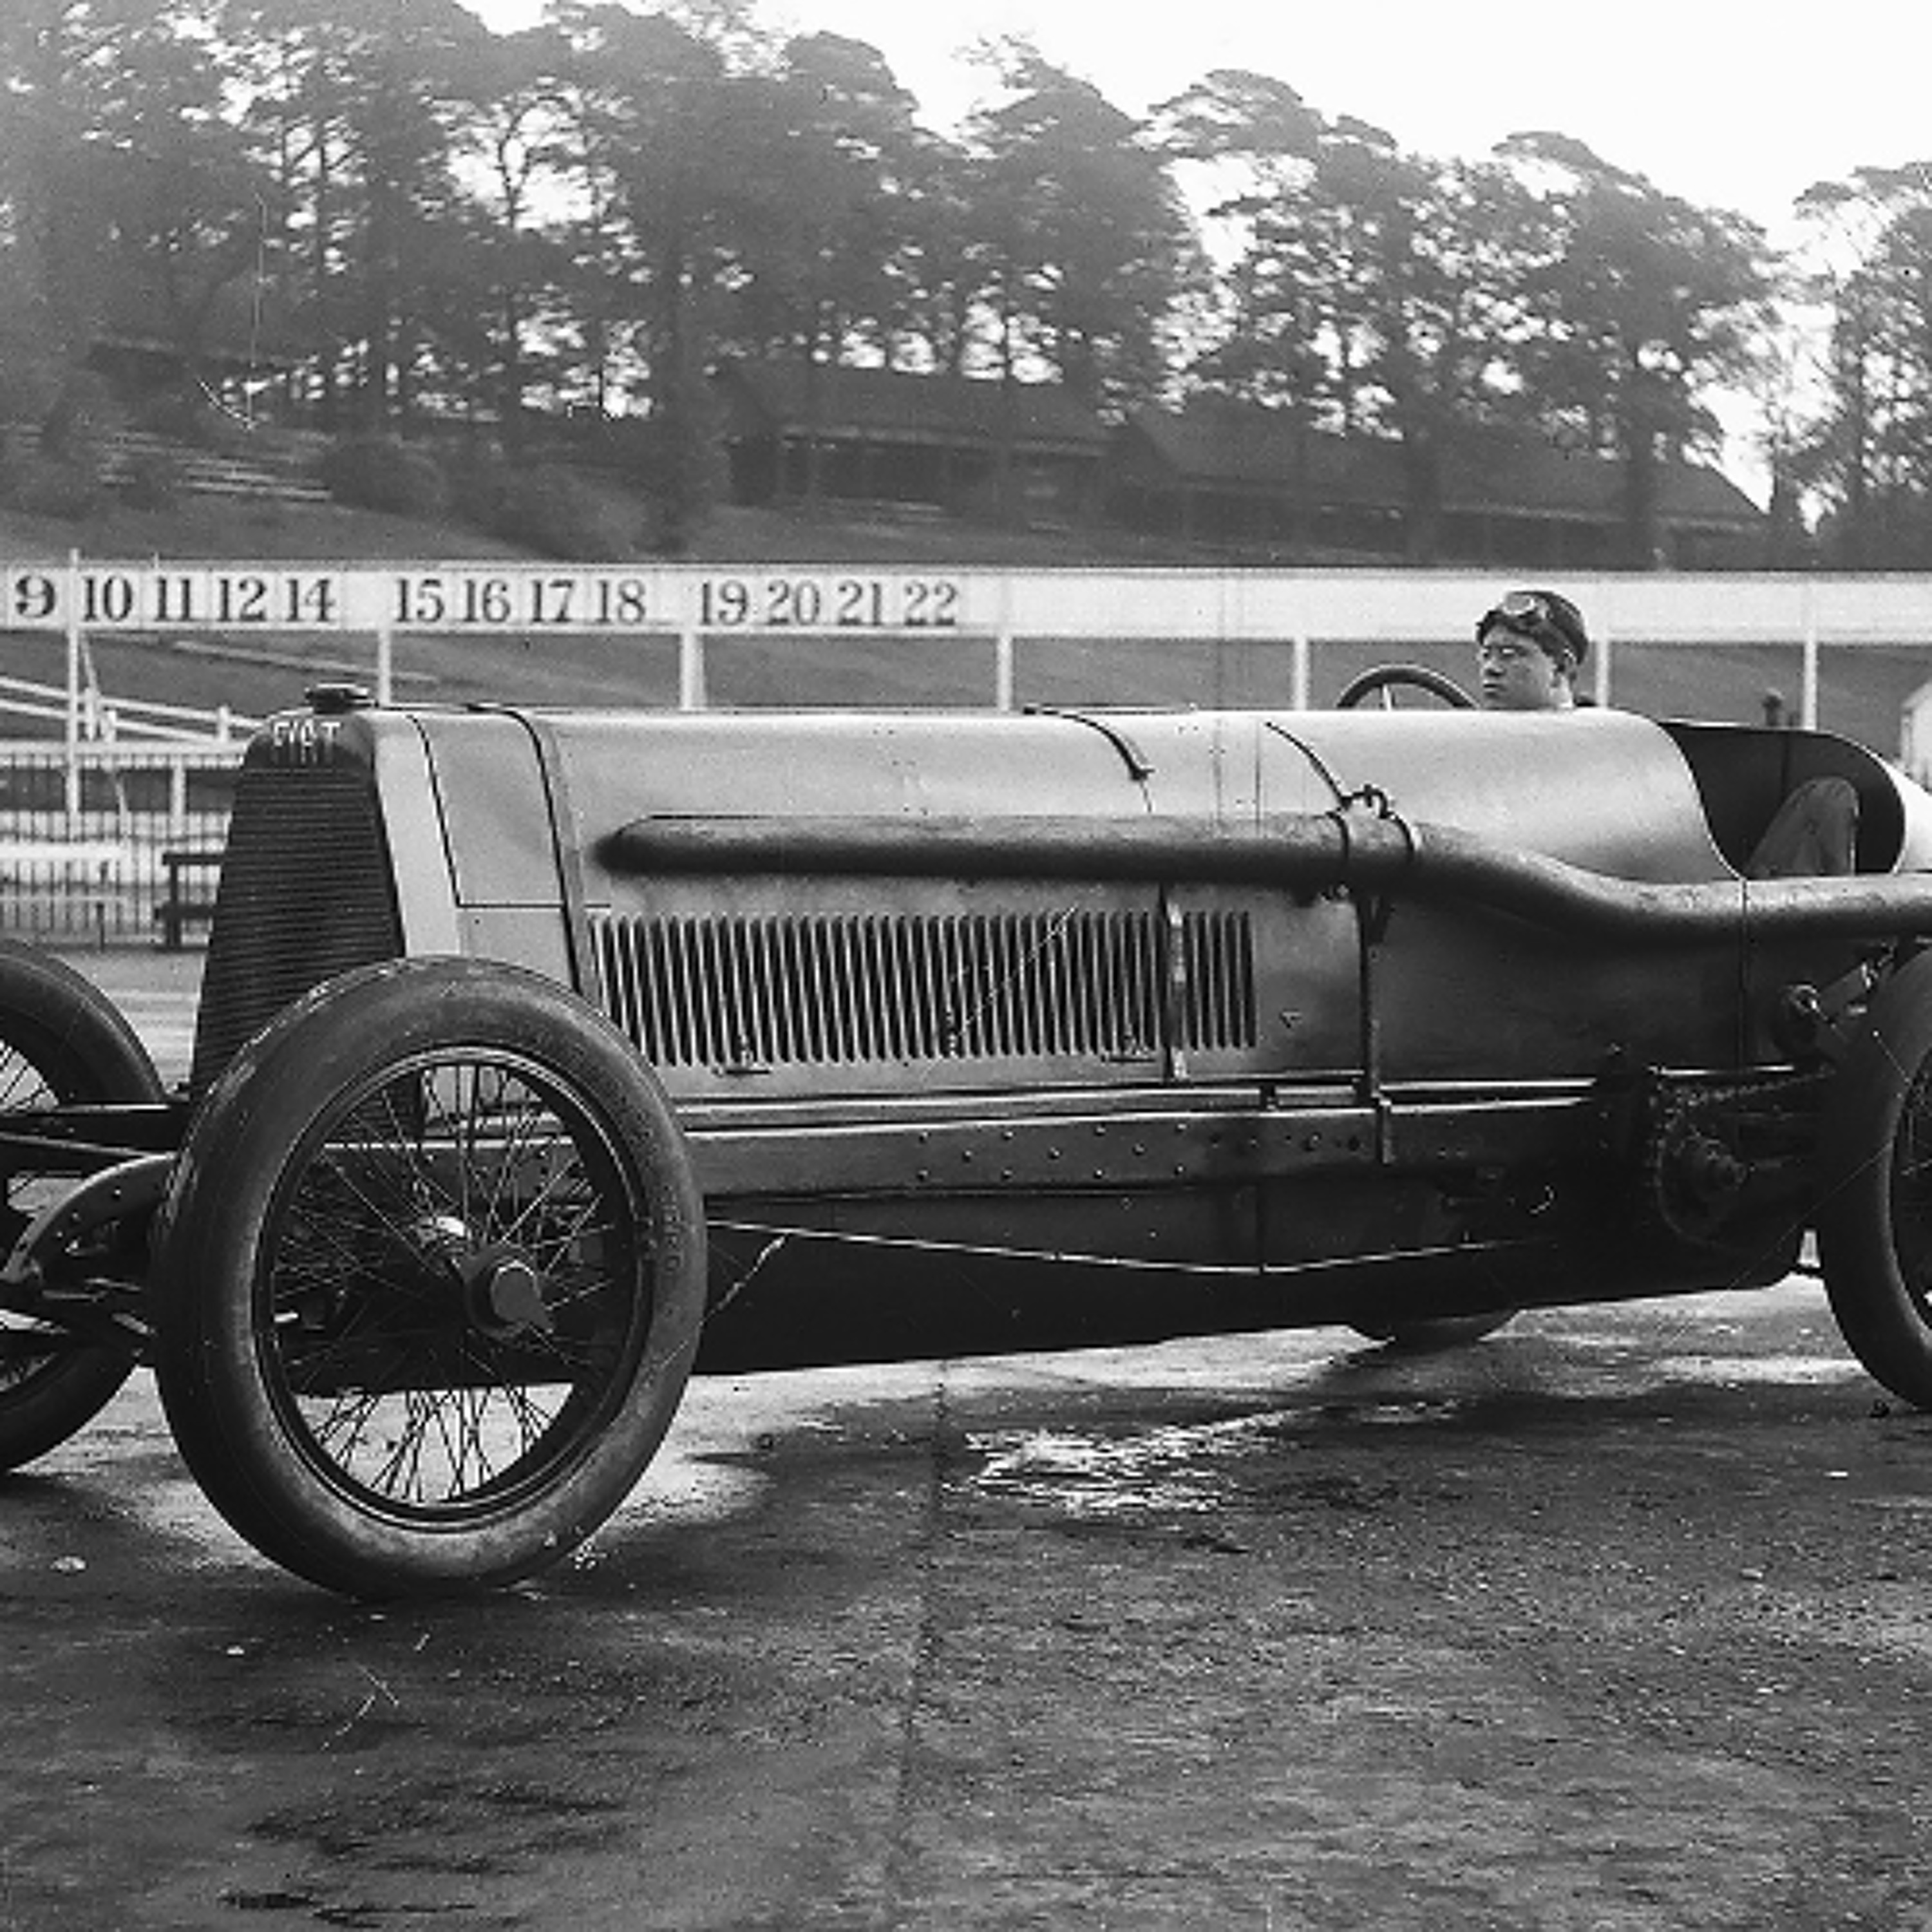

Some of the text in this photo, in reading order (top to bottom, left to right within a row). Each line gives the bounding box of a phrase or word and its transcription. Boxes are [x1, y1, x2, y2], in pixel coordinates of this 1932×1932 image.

[15, 575, 958, 627] 9 10 11 12 14 15 16 17 18 19 20 21 22
[273, 718, 342, 762] FIAT
